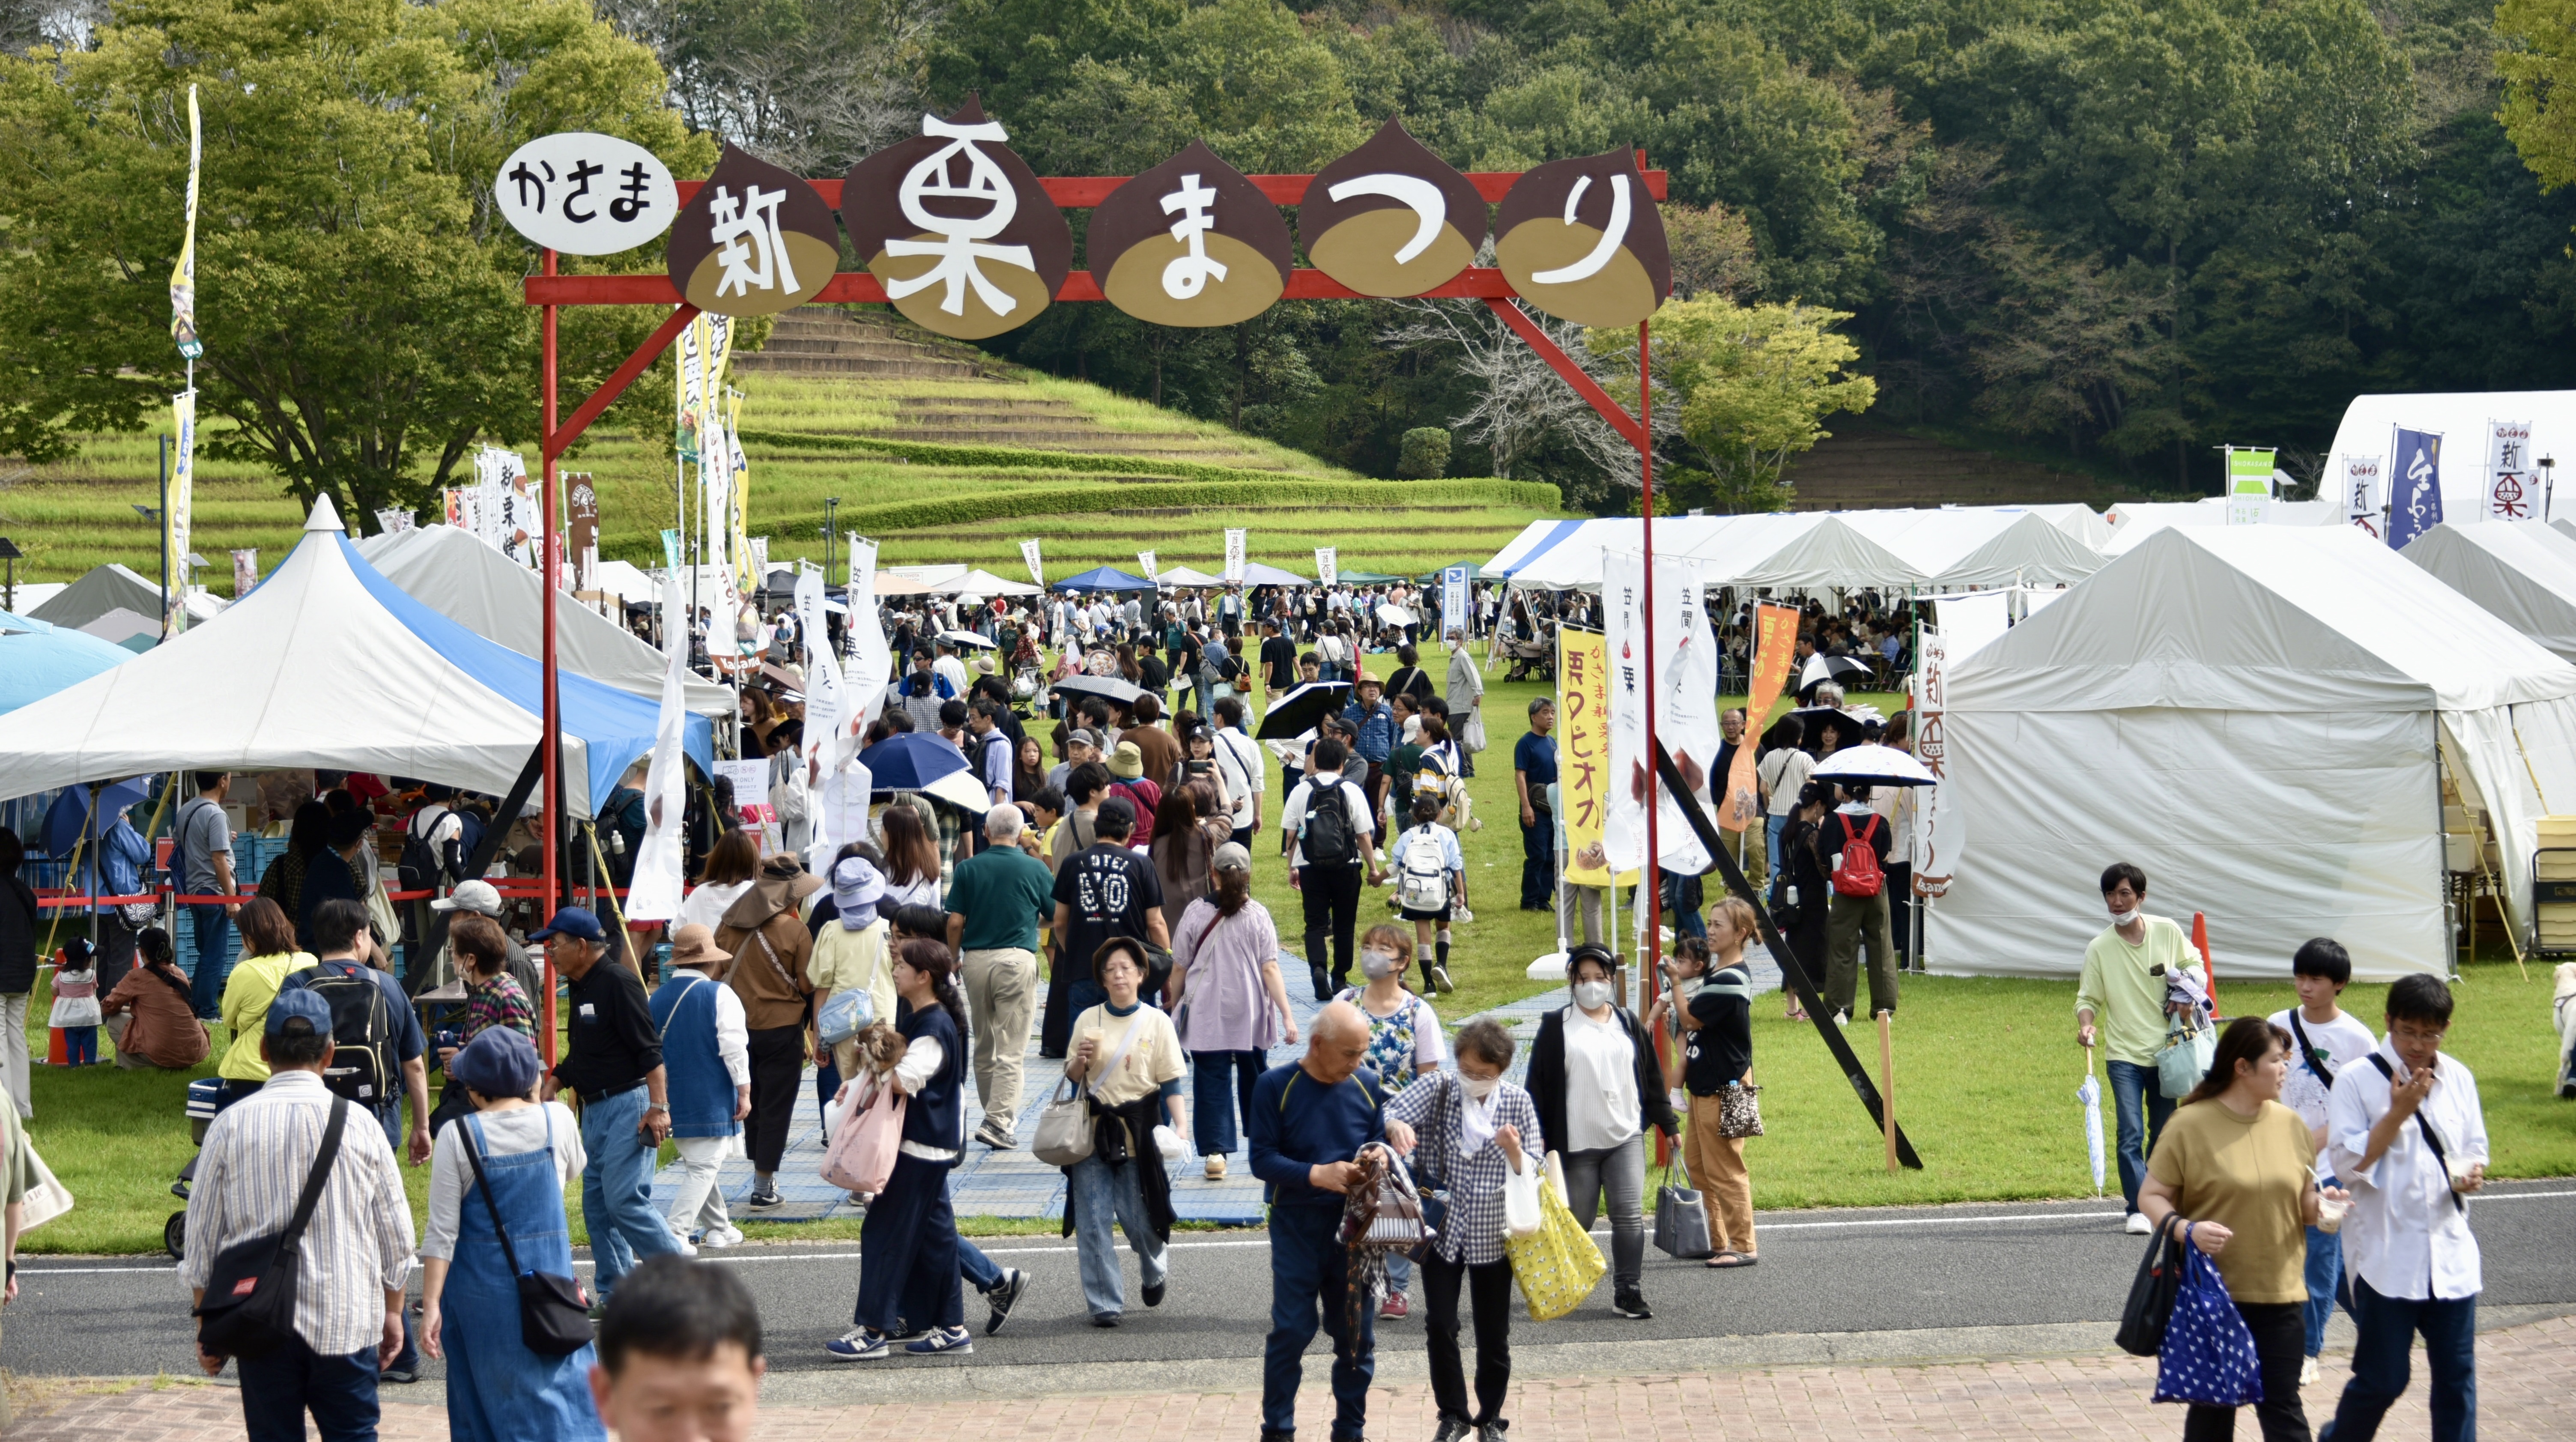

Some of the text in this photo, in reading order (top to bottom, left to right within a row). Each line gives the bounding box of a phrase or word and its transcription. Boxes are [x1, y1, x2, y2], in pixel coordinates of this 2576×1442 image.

[509, 159, 651, 223] かさま
[710, 113, 1630, 317] 新栗まつり
[2496, 428, 2528, 439] かさま
[2350, 464, 2377, 476] かさま
[2493, 441, 2528, 521] 新栗
[1566, 648, 1597, 830] 栗タピオカ
